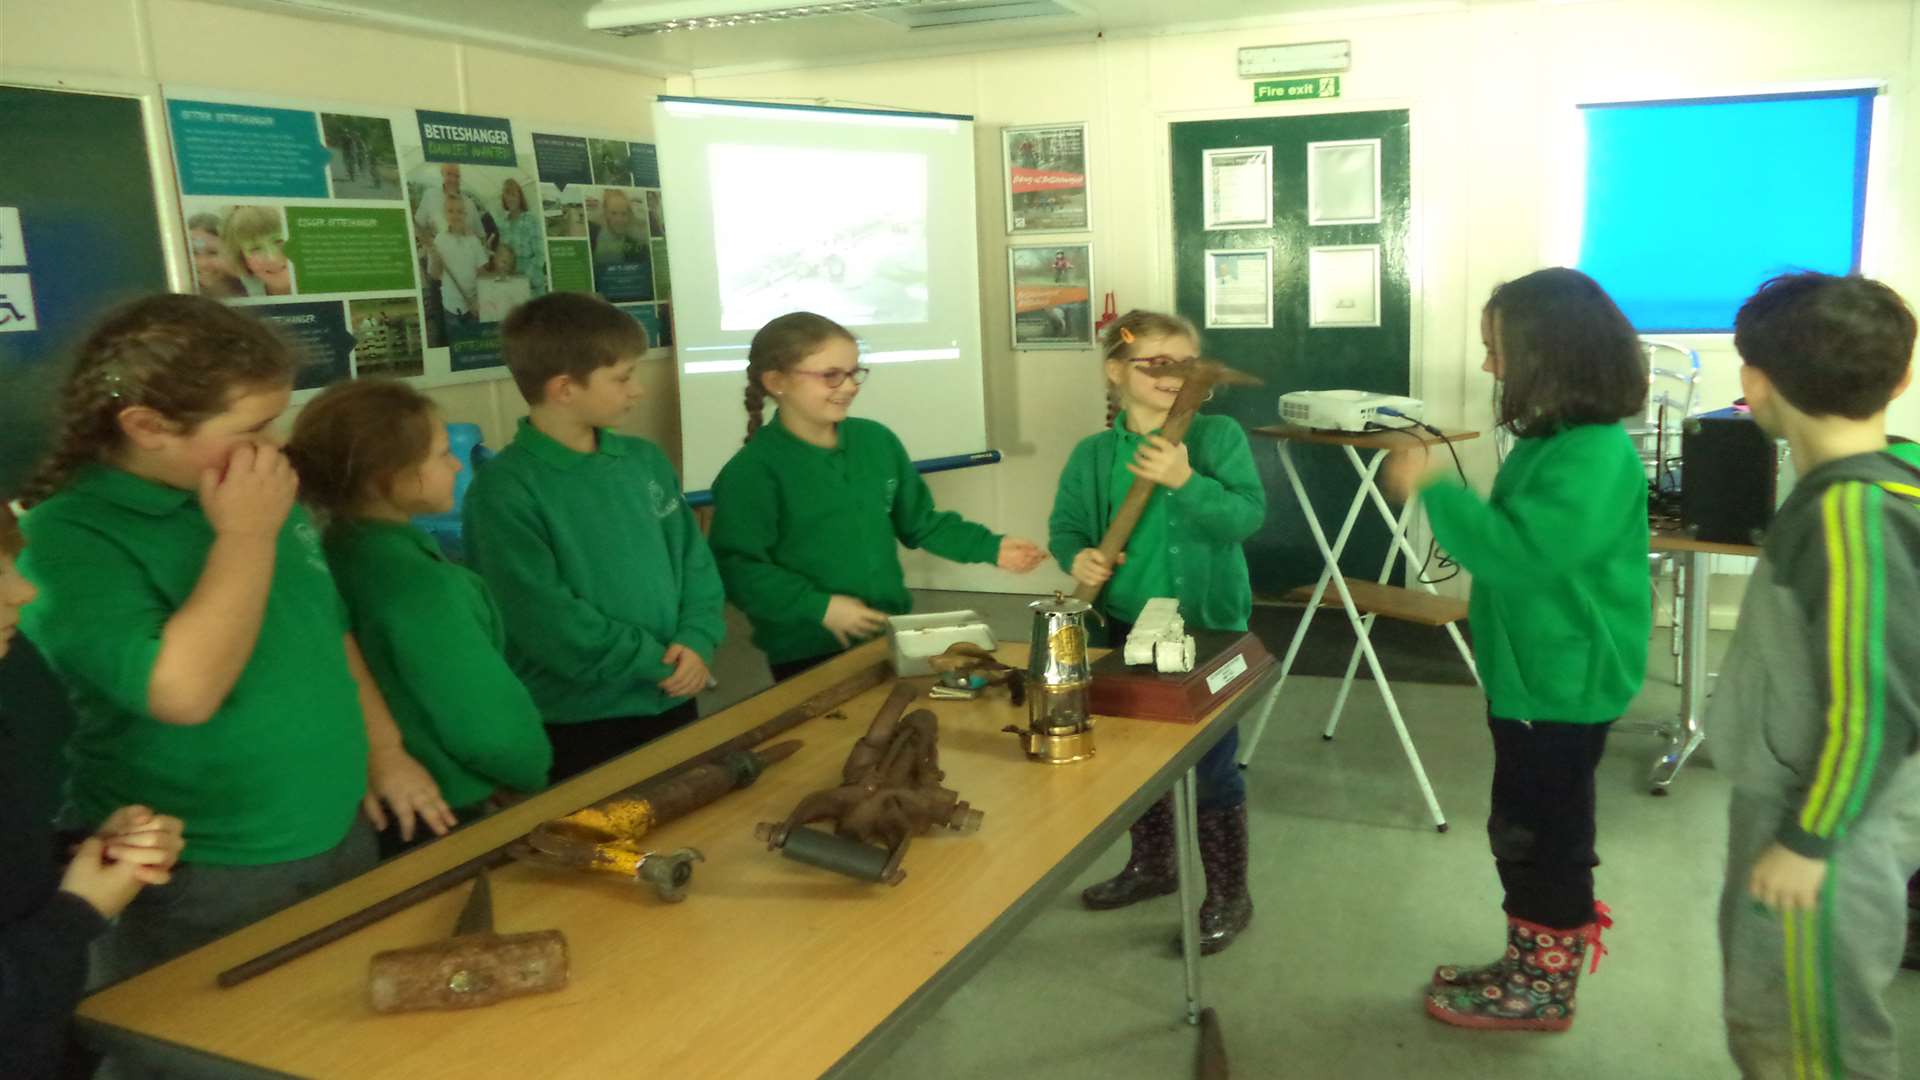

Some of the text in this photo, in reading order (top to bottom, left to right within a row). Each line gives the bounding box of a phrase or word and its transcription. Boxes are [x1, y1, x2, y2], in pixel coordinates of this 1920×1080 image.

[1259, 83, 1314, 97] Fire exit
[423, 123, 510, 145] BETTESHANGER
